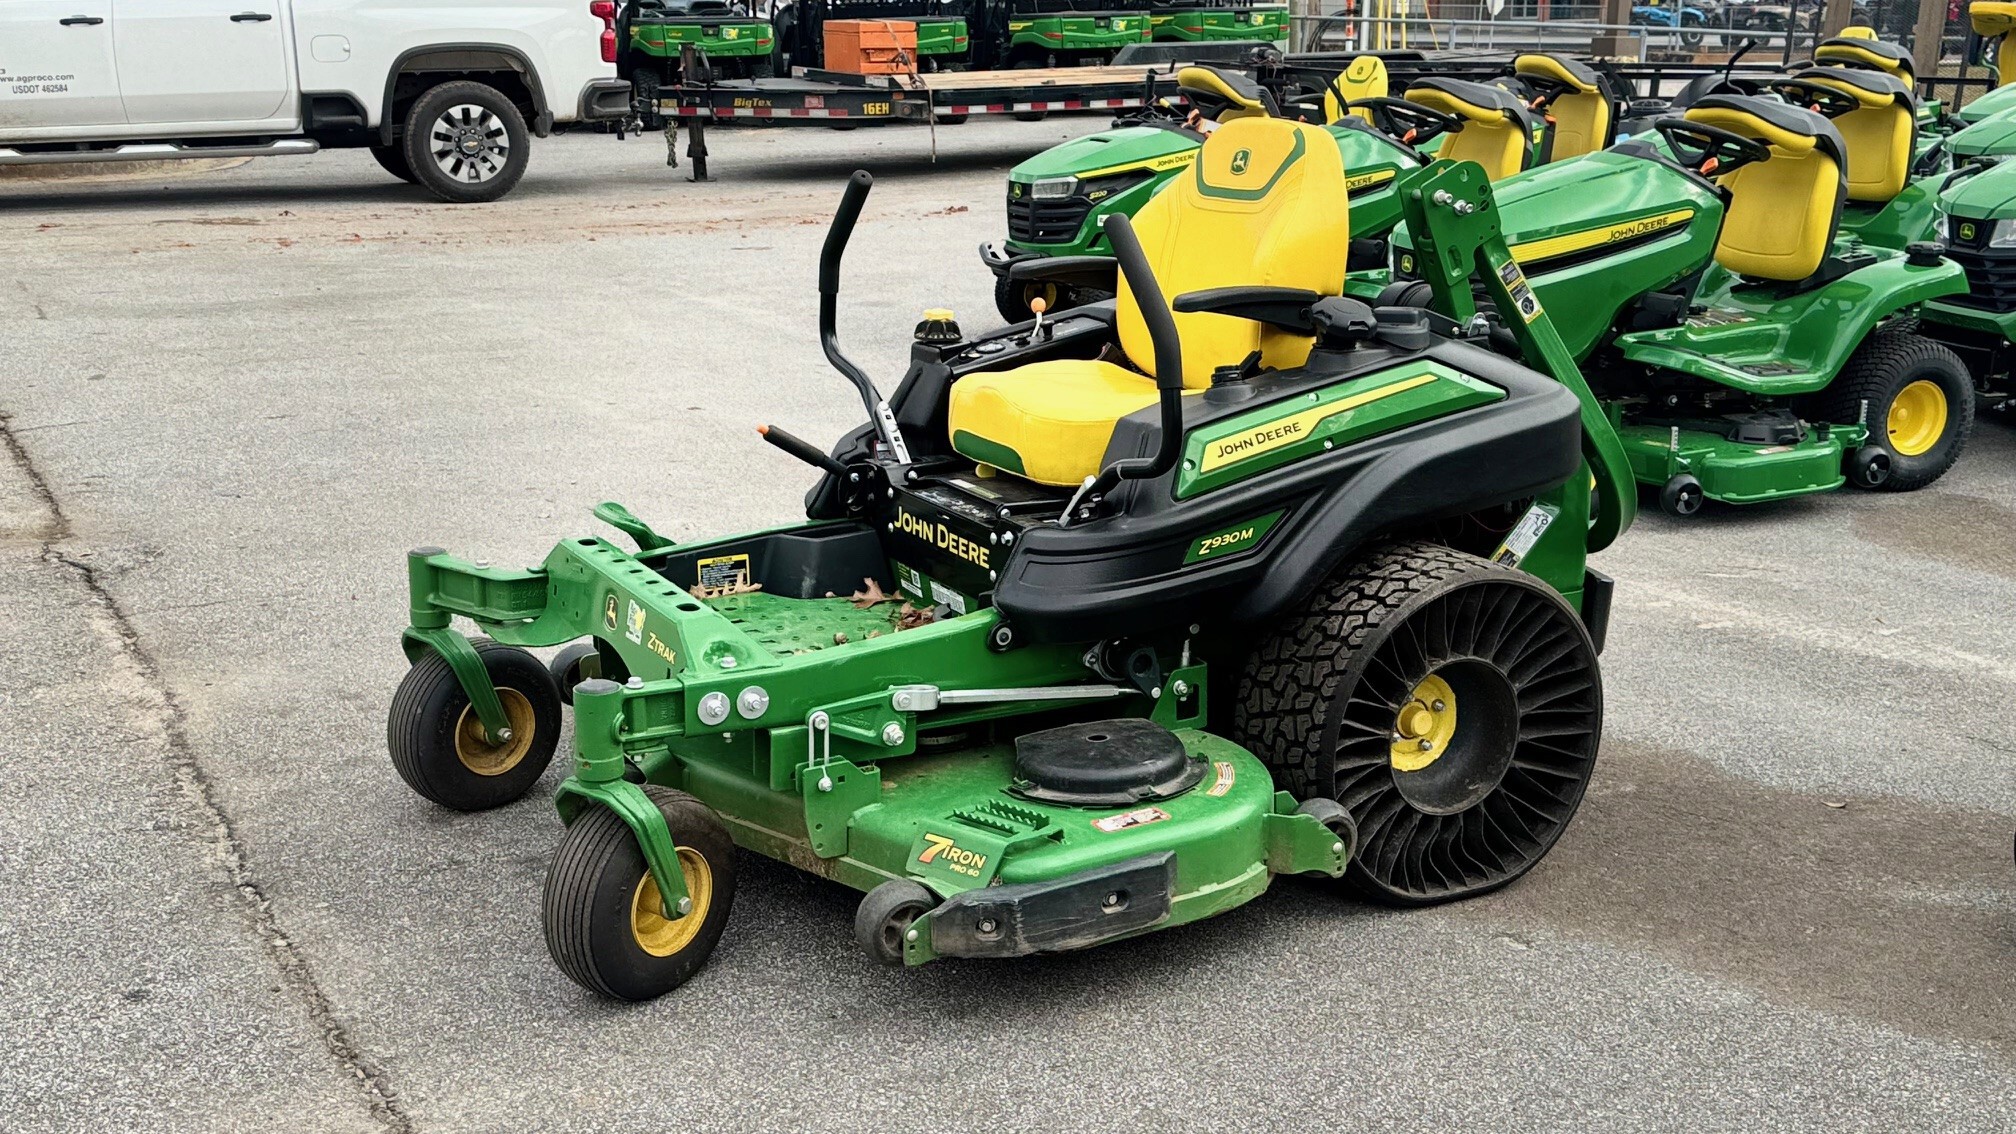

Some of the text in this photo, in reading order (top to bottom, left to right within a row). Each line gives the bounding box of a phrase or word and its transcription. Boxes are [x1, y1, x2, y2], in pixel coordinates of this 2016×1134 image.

[12, 84, 68, 94] USDOT 462584
[863, 102, 890, 115] 16EH
[1156, 153, 1196, 168] JOHN DEERE
[1606, 217, 1669, 242] JOHN DEERE
[1217, 422, 1302, 458] JOHN DEERE
[894, 505, 990, 569] JOHN DEERE
[1198, 527, 1254, 555] Z930M
[647, 631, 677, 665] ZTRAK
[949, 863, 980, 877] PRO 60
